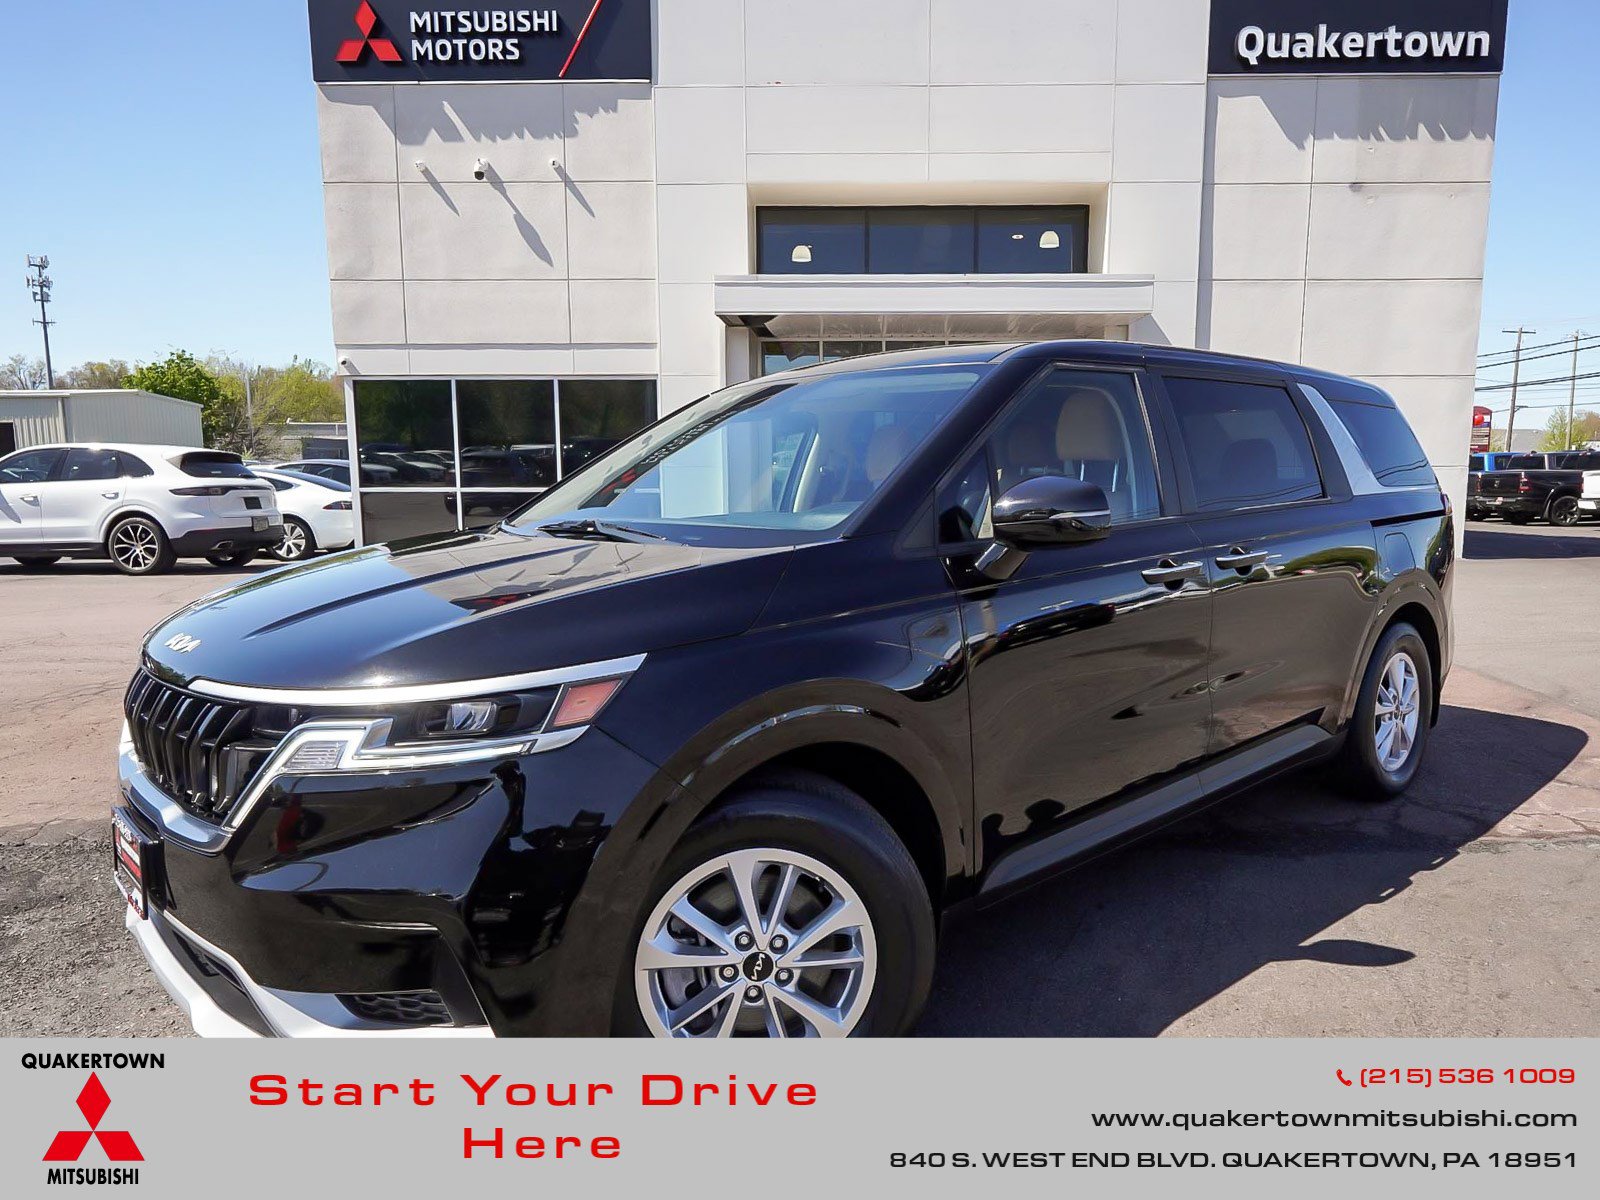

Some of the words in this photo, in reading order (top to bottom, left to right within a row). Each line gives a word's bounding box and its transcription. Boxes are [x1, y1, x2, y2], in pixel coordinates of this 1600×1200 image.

[409, 10, 558, 33] MITSUBISHI
[411, 38, 520, 61] MOTORS
[1237, 23, 1490, 65] Quakertown
